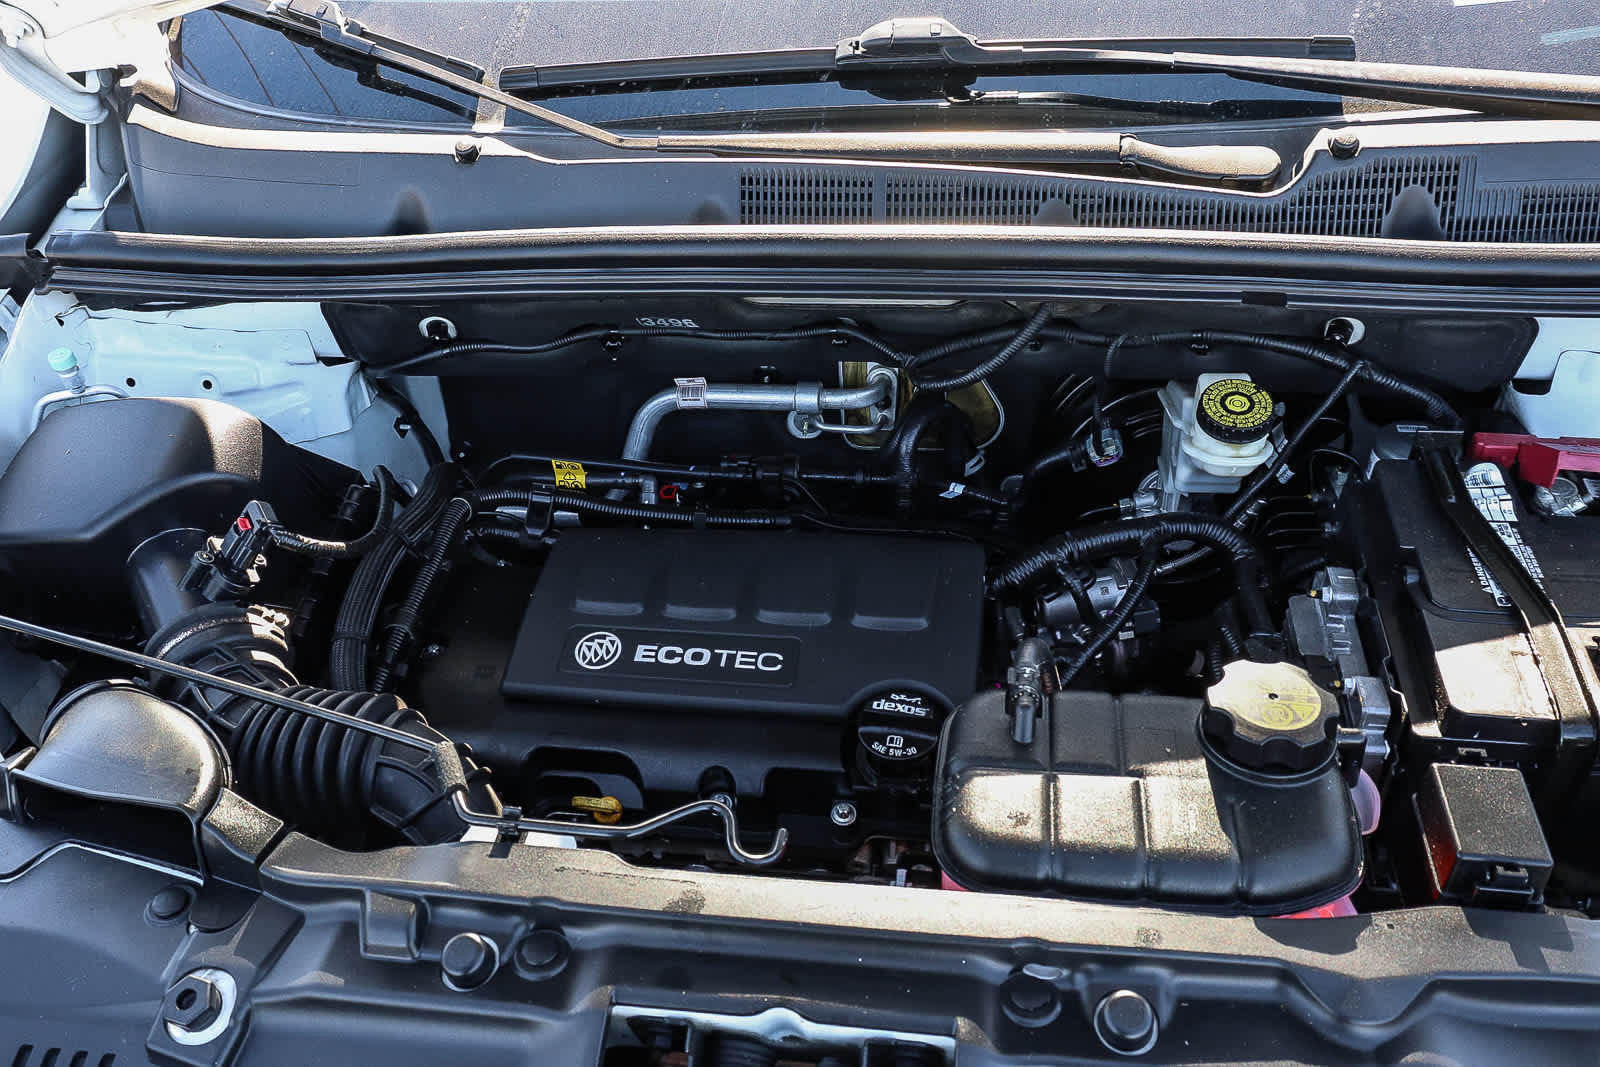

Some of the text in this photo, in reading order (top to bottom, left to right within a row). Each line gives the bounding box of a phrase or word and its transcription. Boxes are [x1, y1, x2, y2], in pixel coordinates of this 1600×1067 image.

[633, 644, 784, 672] ECOTEC
[871, 698, 927, 717] dexos
[871, 741, 917, 757] SAE 5W-30
